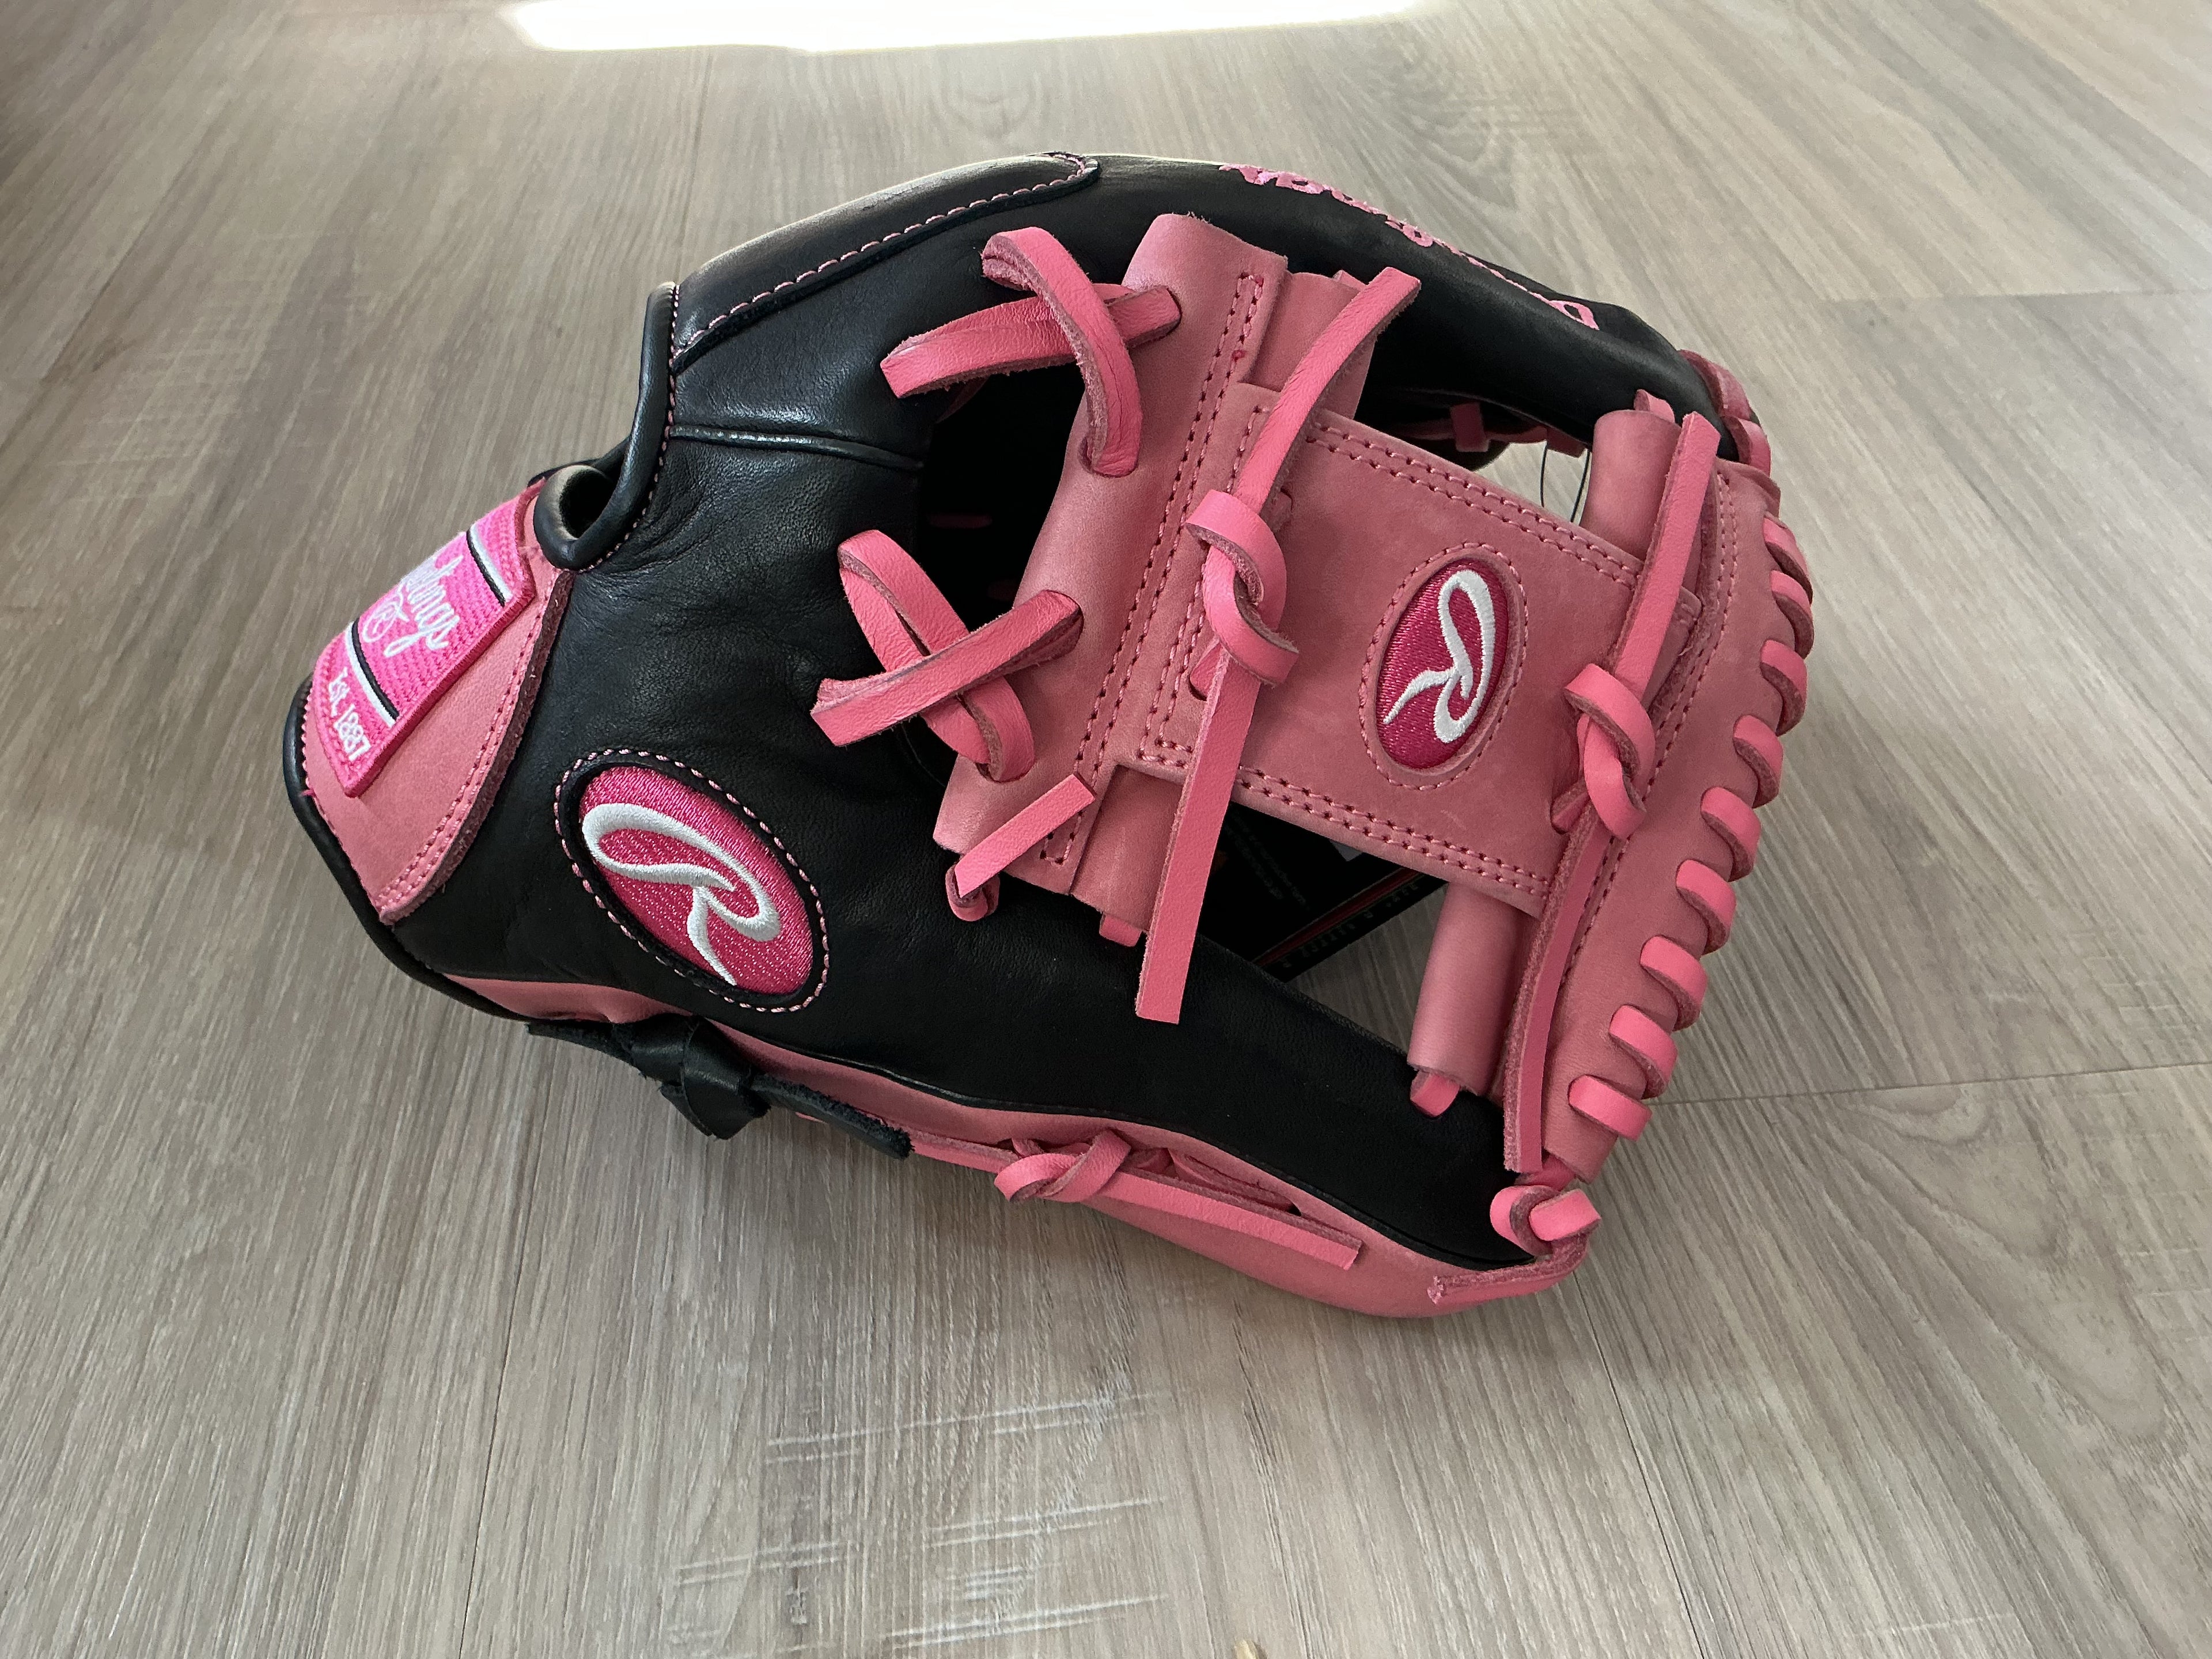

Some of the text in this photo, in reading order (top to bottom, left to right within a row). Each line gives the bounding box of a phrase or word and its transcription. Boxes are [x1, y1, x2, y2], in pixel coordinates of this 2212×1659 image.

[334, 703, 372, 761] 1887
[1383, 569, 1496, 743] R
[582, 803, 780, 986] R
